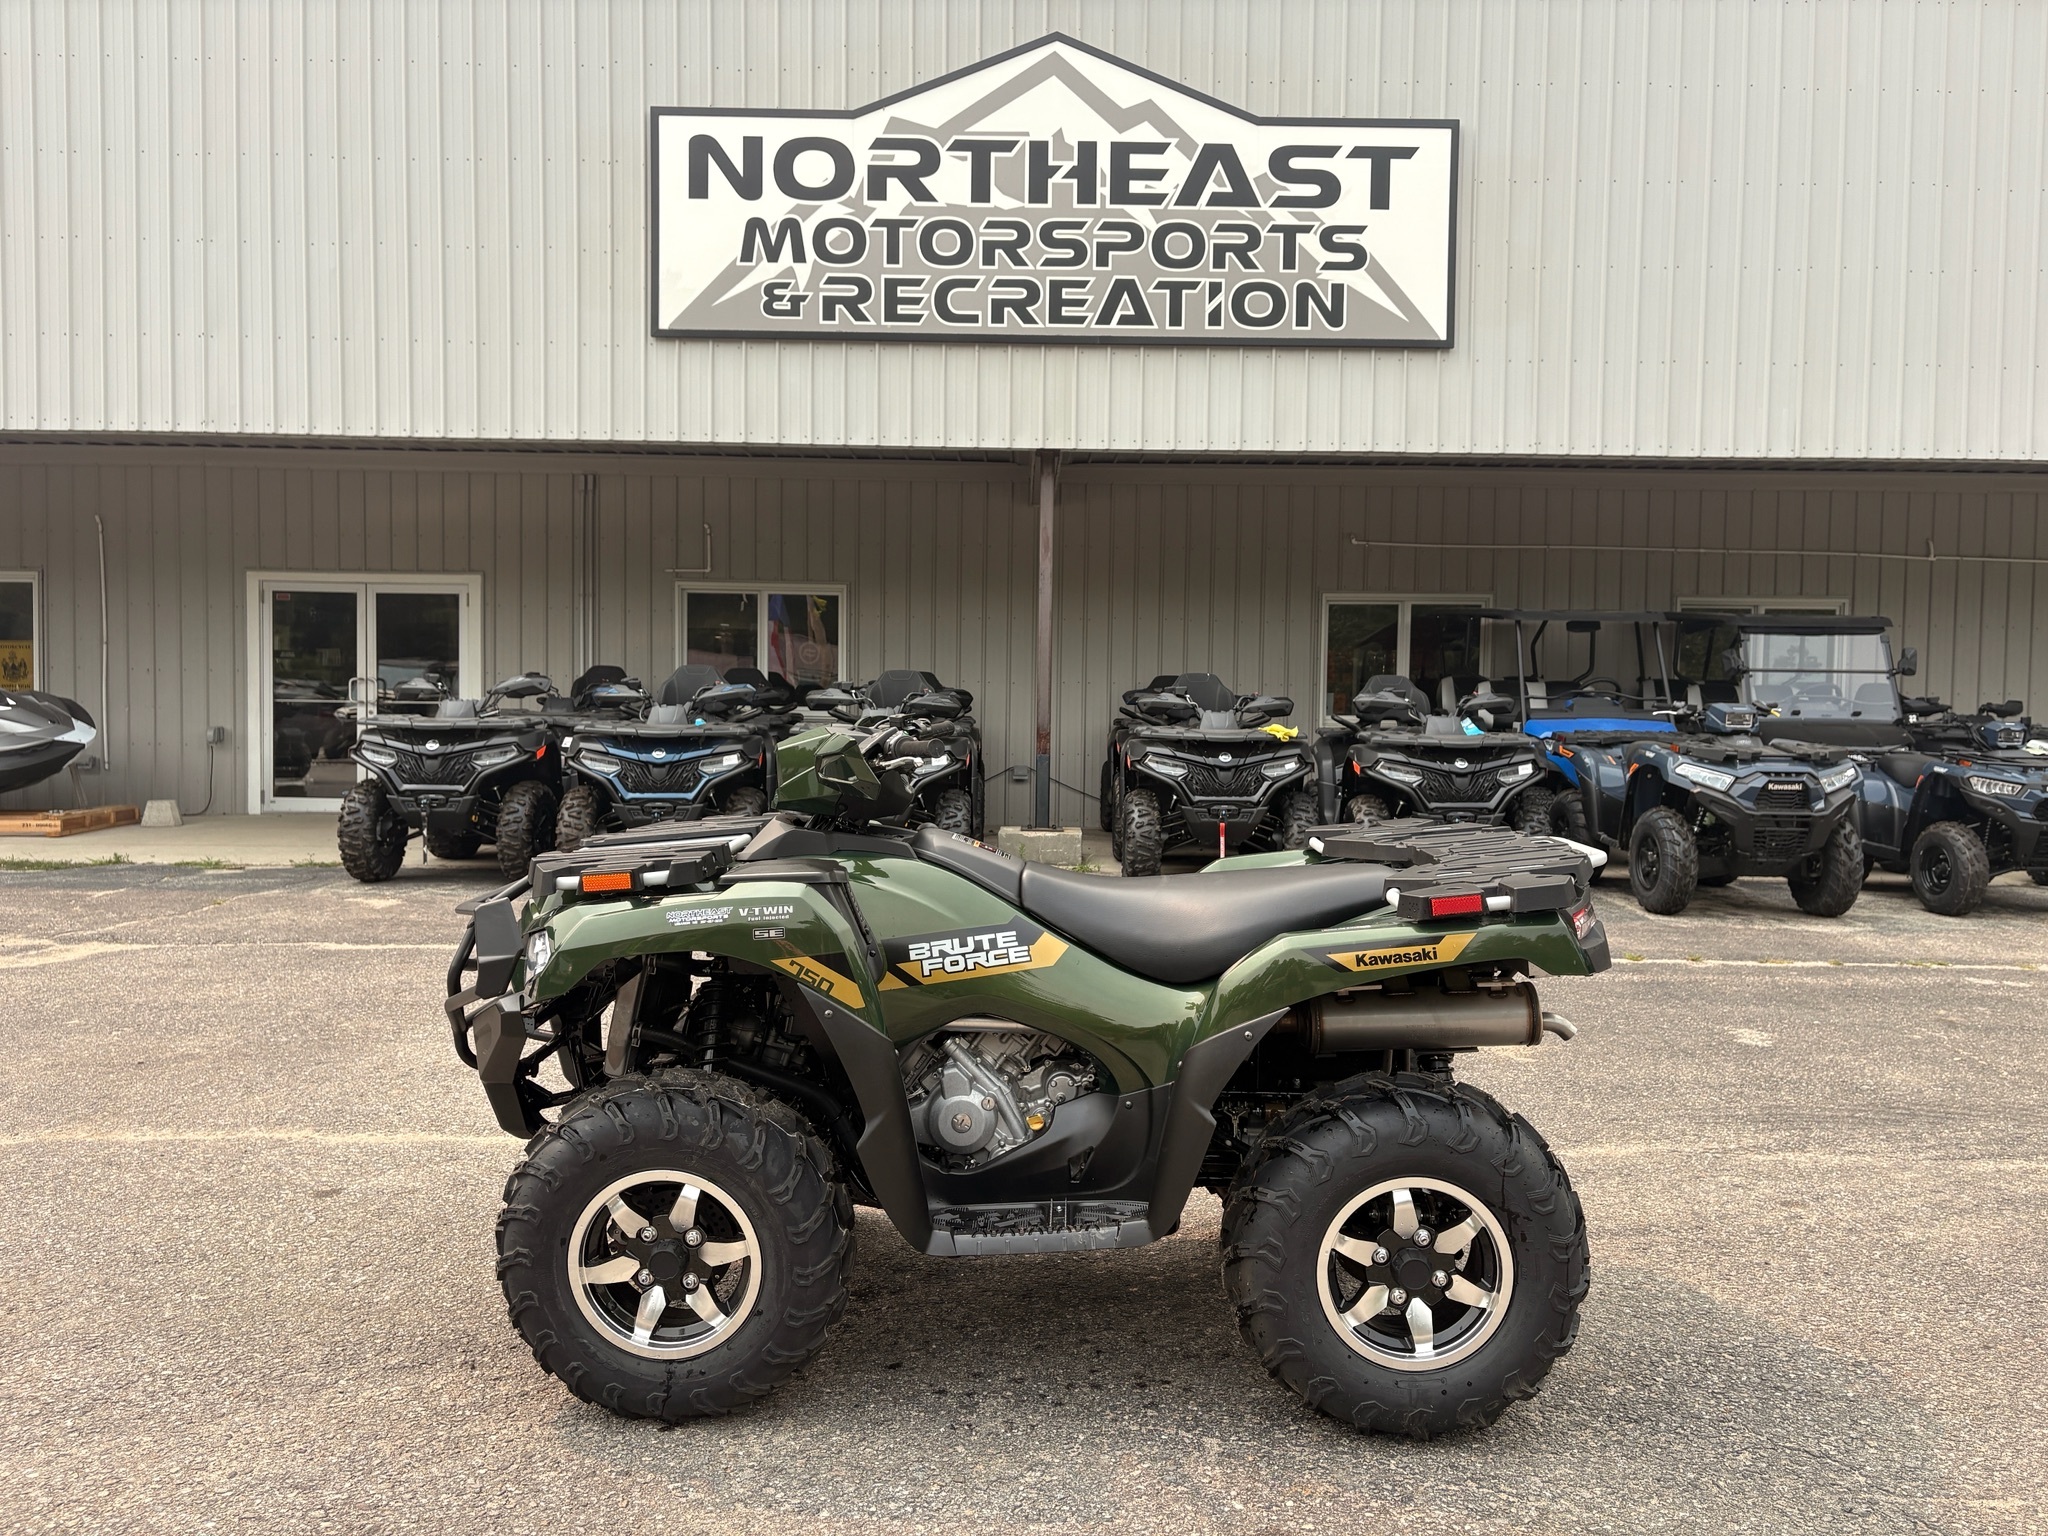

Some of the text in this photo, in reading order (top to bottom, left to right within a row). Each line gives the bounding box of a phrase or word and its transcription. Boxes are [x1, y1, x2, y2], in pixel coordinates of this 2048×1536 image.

[688, 134, 1420, 210] NORTHEAST
[739, 216, 1369, 271] MOTORSPORTS
[1768, 783, 1803, 791] Kawasaki
[666, 906, 733, 919] NORTHEAST
[739, 905, 794, 917] V-TWIN
[754, 928, 784, 939] SE
[908, 930, 1019, 961] BRUTE
[921, 945, 1031, 977] FORCE
[1355, 946, 1438, 967] Kawasaki
[788, 959, 835, 996] 750
